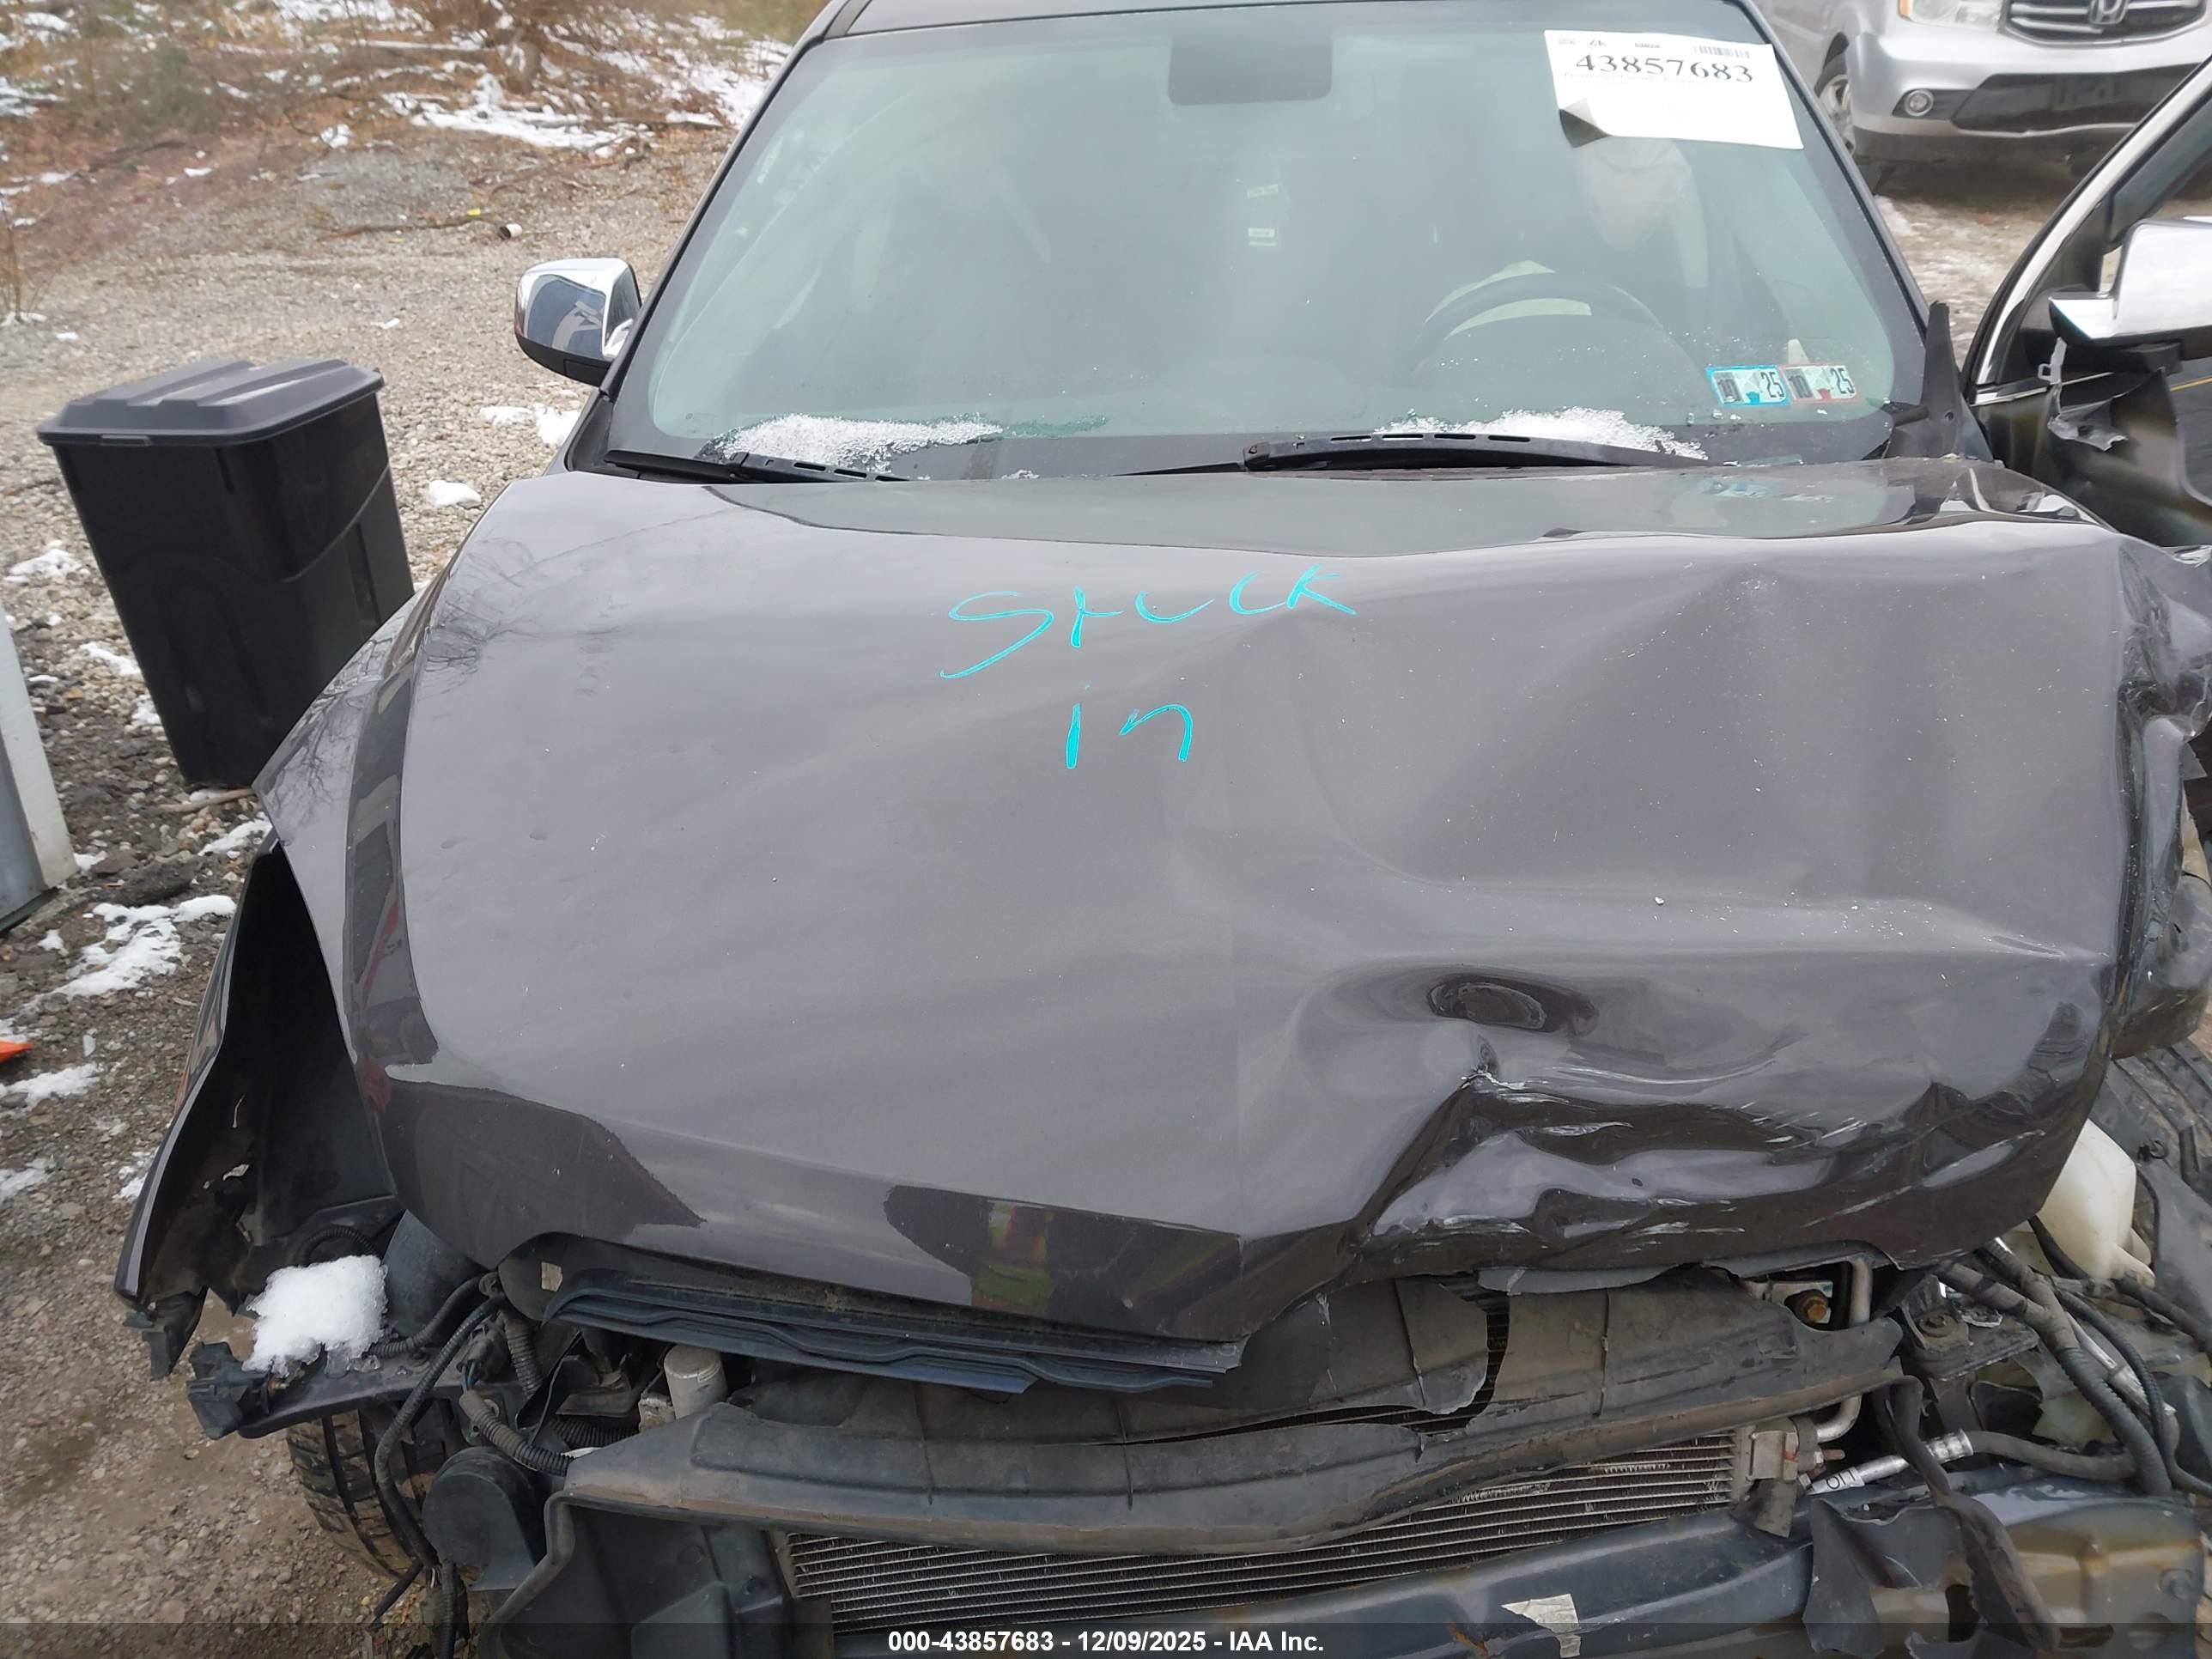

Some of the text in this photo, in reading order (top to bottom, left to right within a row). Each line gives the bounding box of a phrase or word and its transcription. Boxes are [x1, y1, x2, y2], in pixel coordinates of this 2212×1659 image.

[1576, 54, 1753, 83] 43857683
[1760, 371, 1785, 398] 25
[1831, 367, 1855, 394] 25
